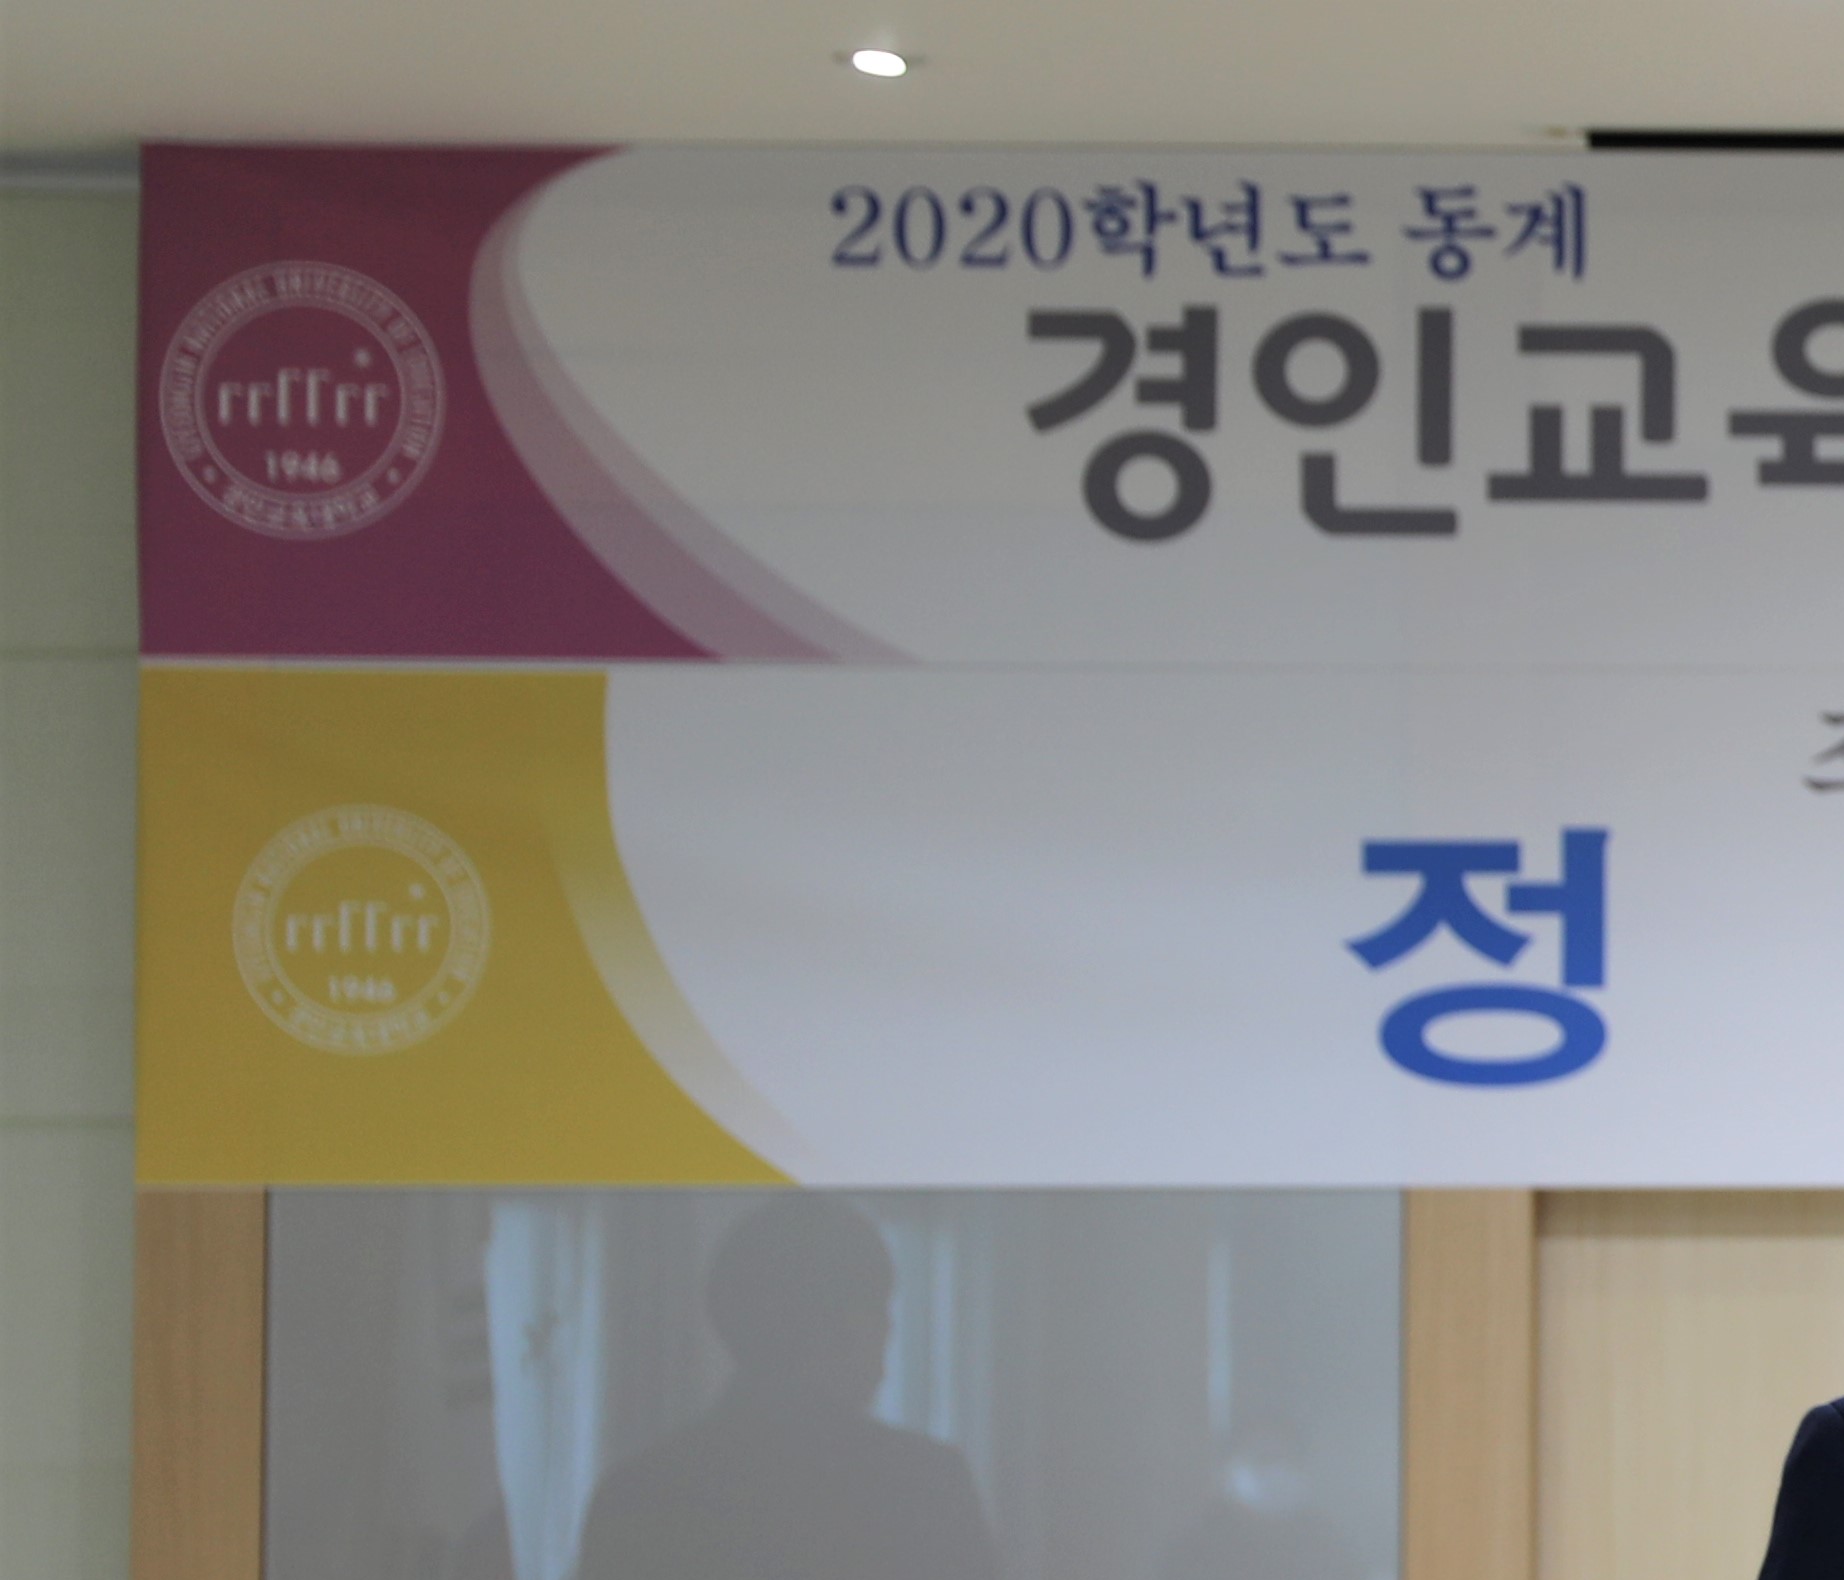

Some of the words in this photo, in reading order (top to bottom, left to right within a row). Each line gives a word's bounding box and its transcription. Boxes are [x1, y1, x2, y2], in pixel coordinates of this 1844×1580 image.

[831, 180, 1369, 277] 2020학년도
[1405, 184, 1585, 281] 동계
[267, 450, 341, 483] 1946
